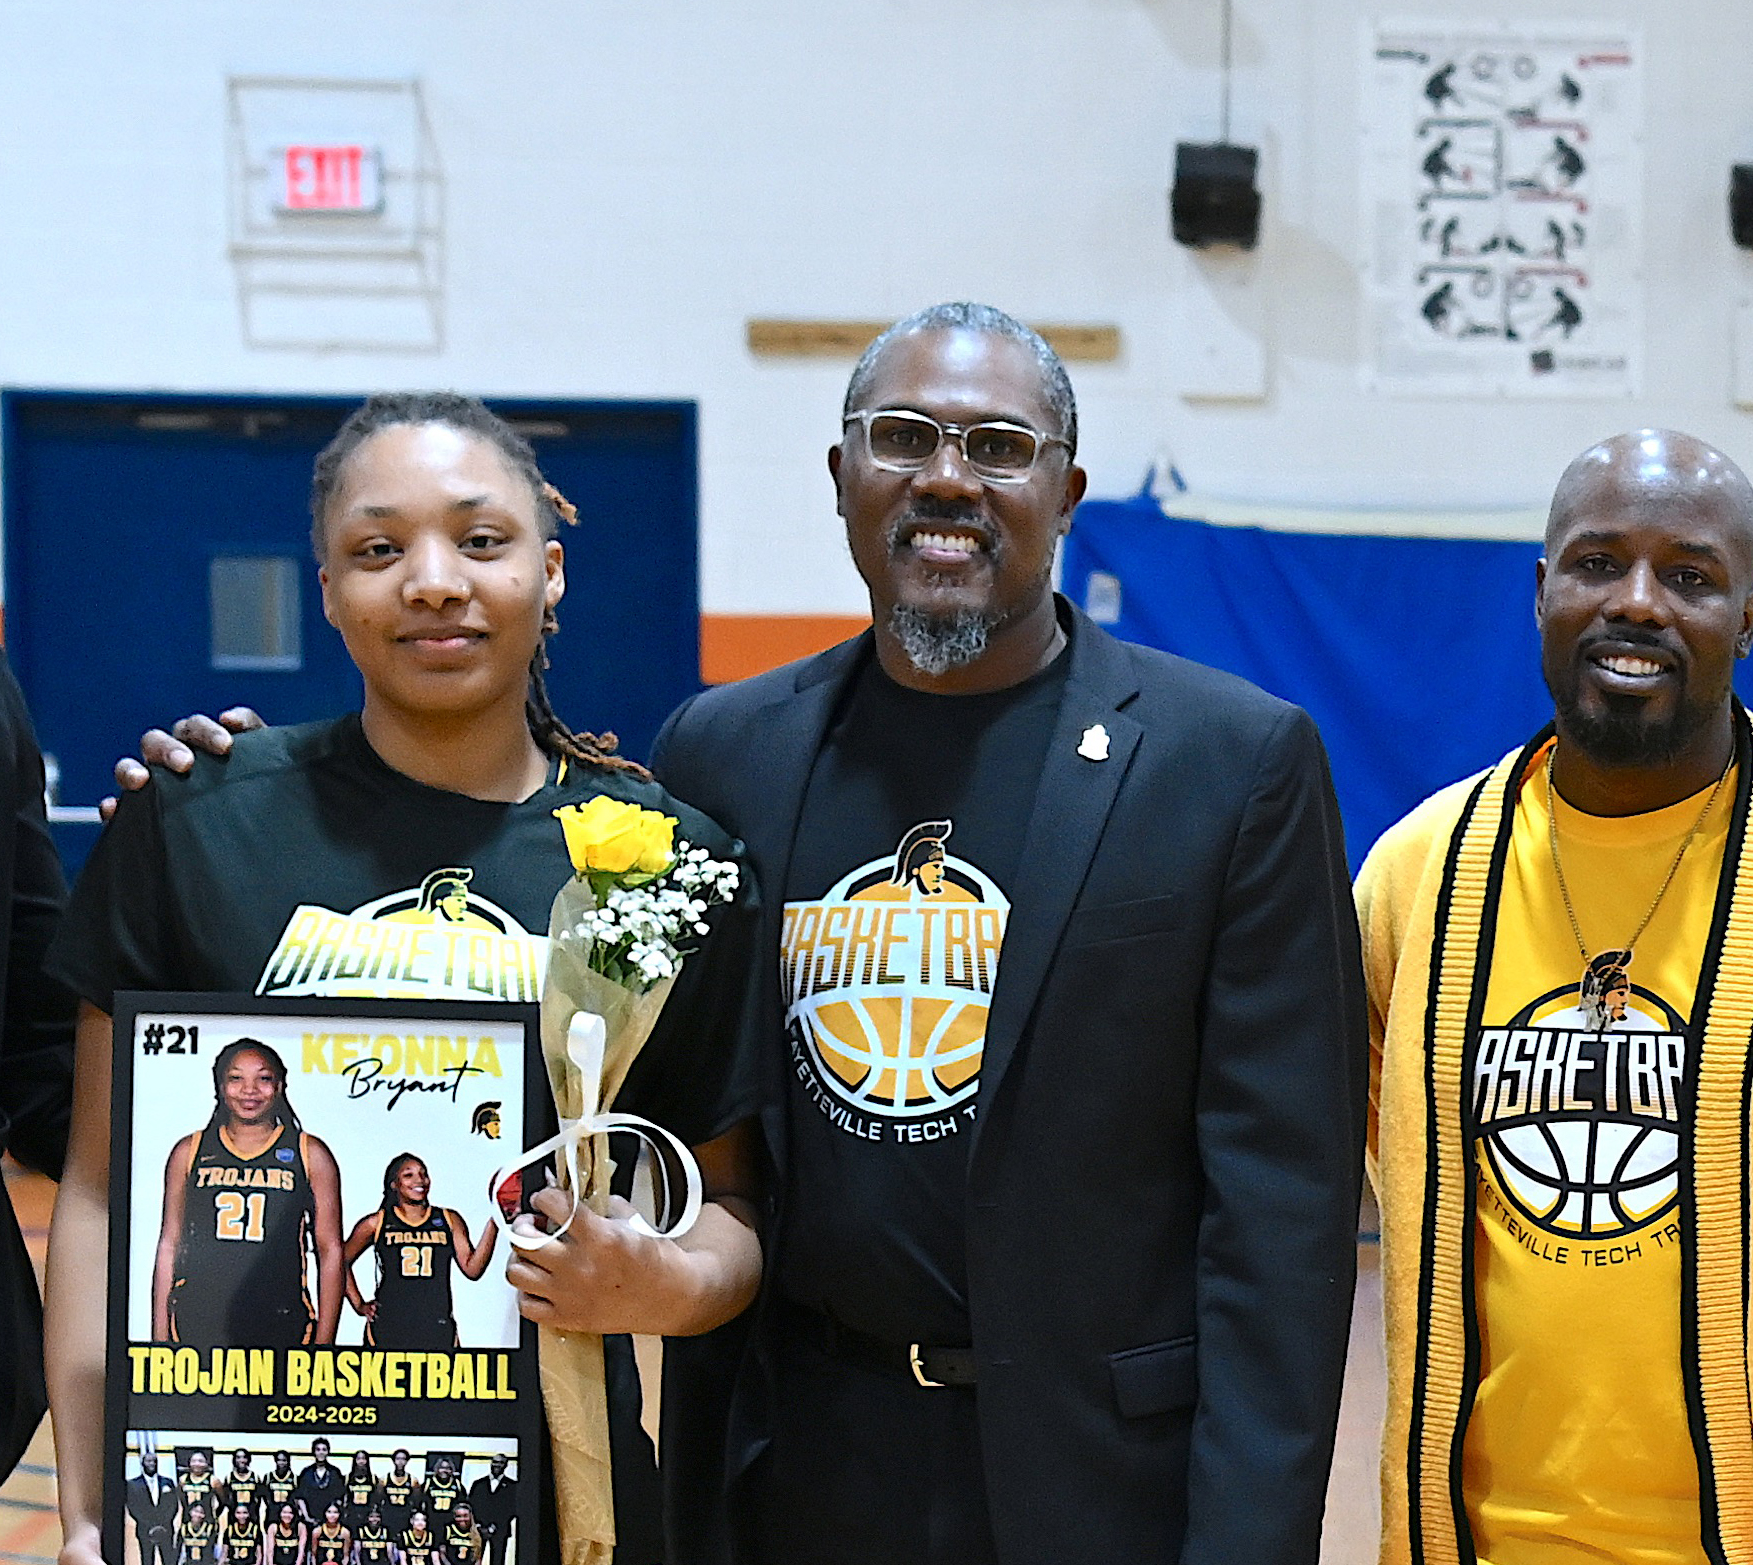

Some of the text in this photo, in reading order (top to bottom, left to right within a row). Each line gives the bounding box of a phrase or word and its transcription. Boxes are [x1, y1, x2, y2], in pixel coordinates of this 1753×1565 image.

[285, 144, 362, 208] EXIT
[143, 1023, 199, 1055] #21
[301, 1032, 503, 1078] KE'ONNA
[342, 1057, 484, 1111] Bryant
[1472, 1029, 1686, 1126] ASKETBA
[893, 1117, 958, 1143] TECH
[197, 1166, 295, 1191] TROJANS
[215, 1192, 265, 1242] 21
[385, 1230, 447, 1246] TROJANS
[1581, 1241, 1642, 1267] TECH
[401, 1247, 433, 1277] 21
[128, 1347, 517, 1401] TROJAN BASKETBALL
[266, 1405, 377, 1425] 2024-2025
